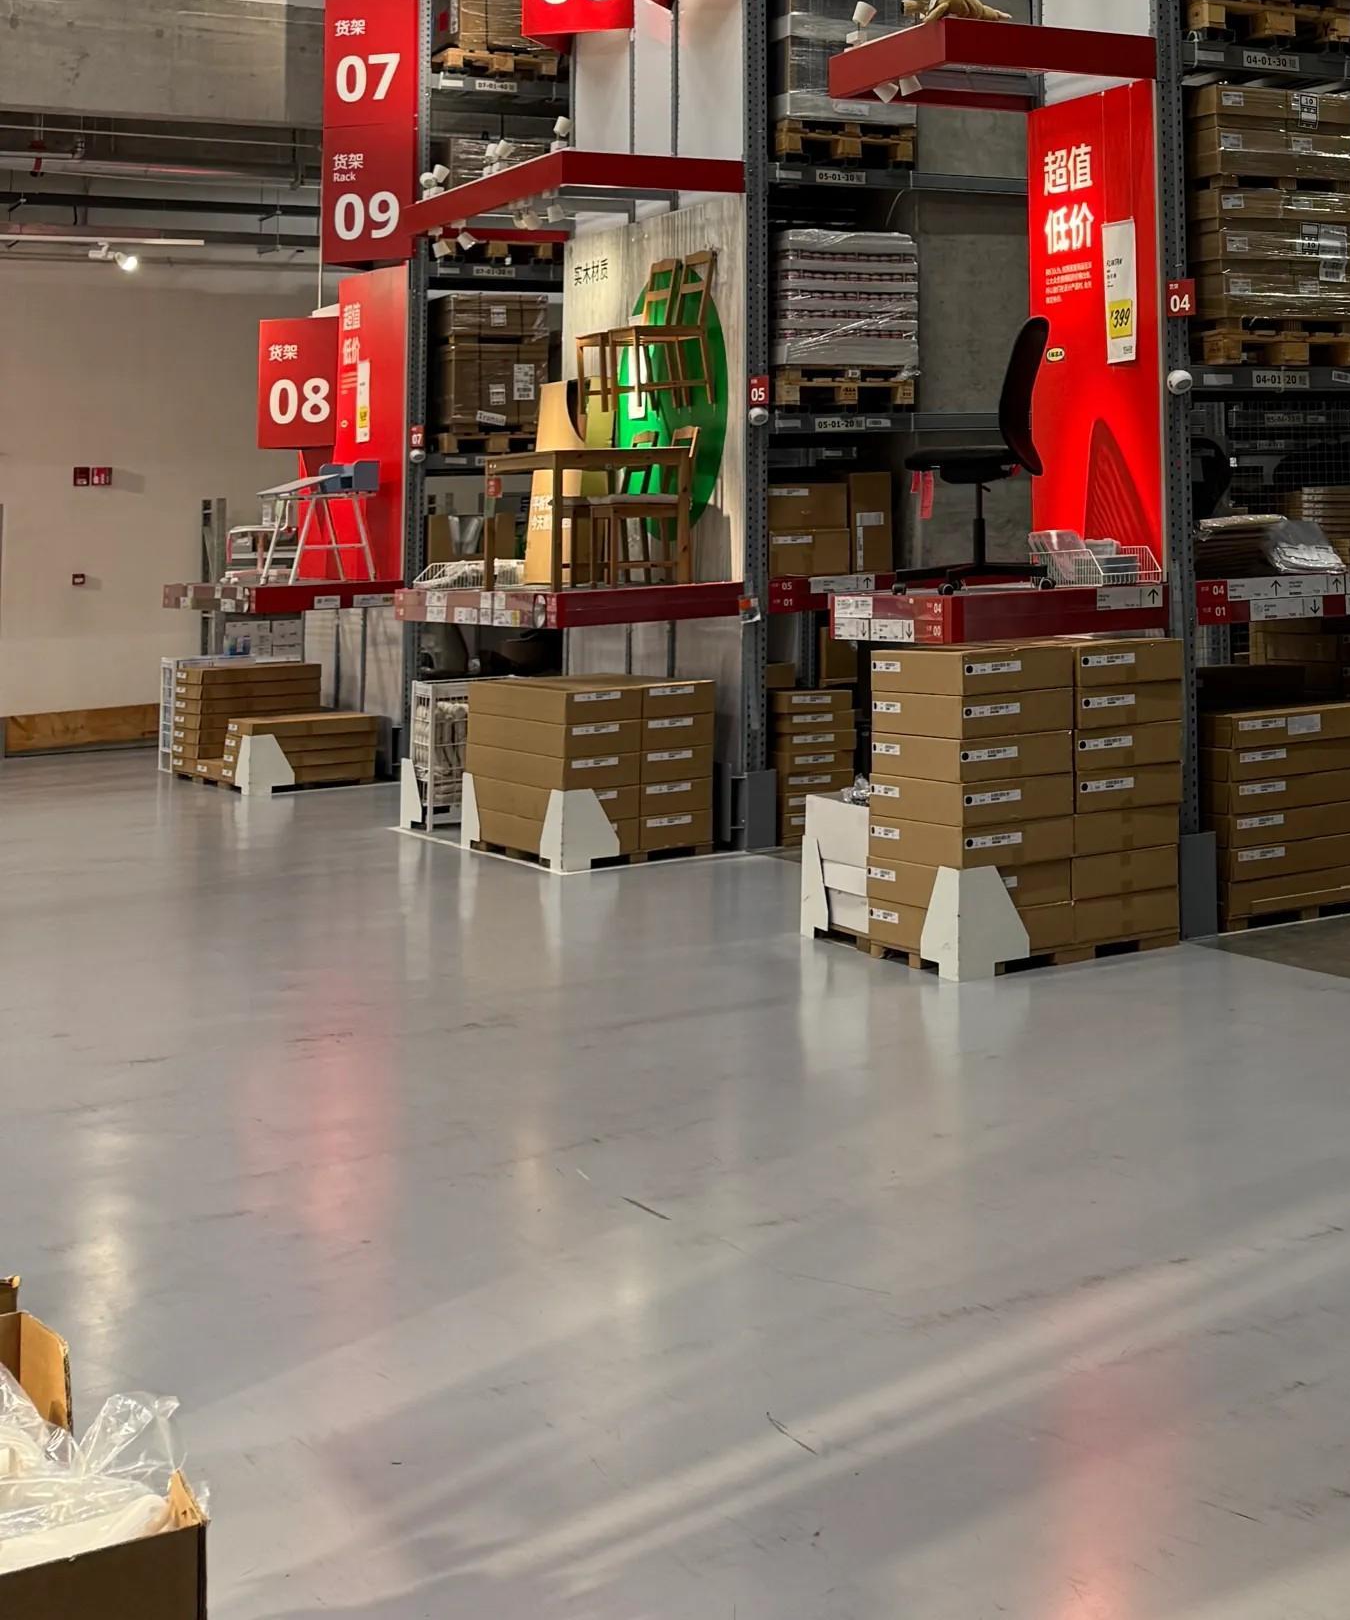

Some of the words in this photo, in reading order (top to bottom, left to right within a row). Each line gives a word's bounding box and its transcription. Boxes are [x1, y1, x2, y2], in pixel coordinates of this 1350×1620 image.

[334, 19, 366, 37] 货架
[1246, 55, 1288, 68] 04-01-30
[336, 52, 401, 103] 07
[333, 153, 364, 171] 货架
[1043, 143, 1093, 196] 超值
[333, 172, 357, 182] Rack
[818, 172, 855, 182] 05-01-30
[334, 191, 400, 241] 09
[1044, 202, 1095, 255] 低价
[573, 258, 609, 287] 实木材质
[1169, 294, 1191, 313] 04
[268, 344, 298, 362] 货架
[1256, 374, 1297, 384] 04-01-20
[269, 377, 331, 424] 08
[751, 387, 765, 401] 05
[818, 420, 855, 429] 05-01-20
[411, 433, 423, 445] 07
[1212, 585, 1225, 595] 04
[1214, 606, 1227, 617] 01
